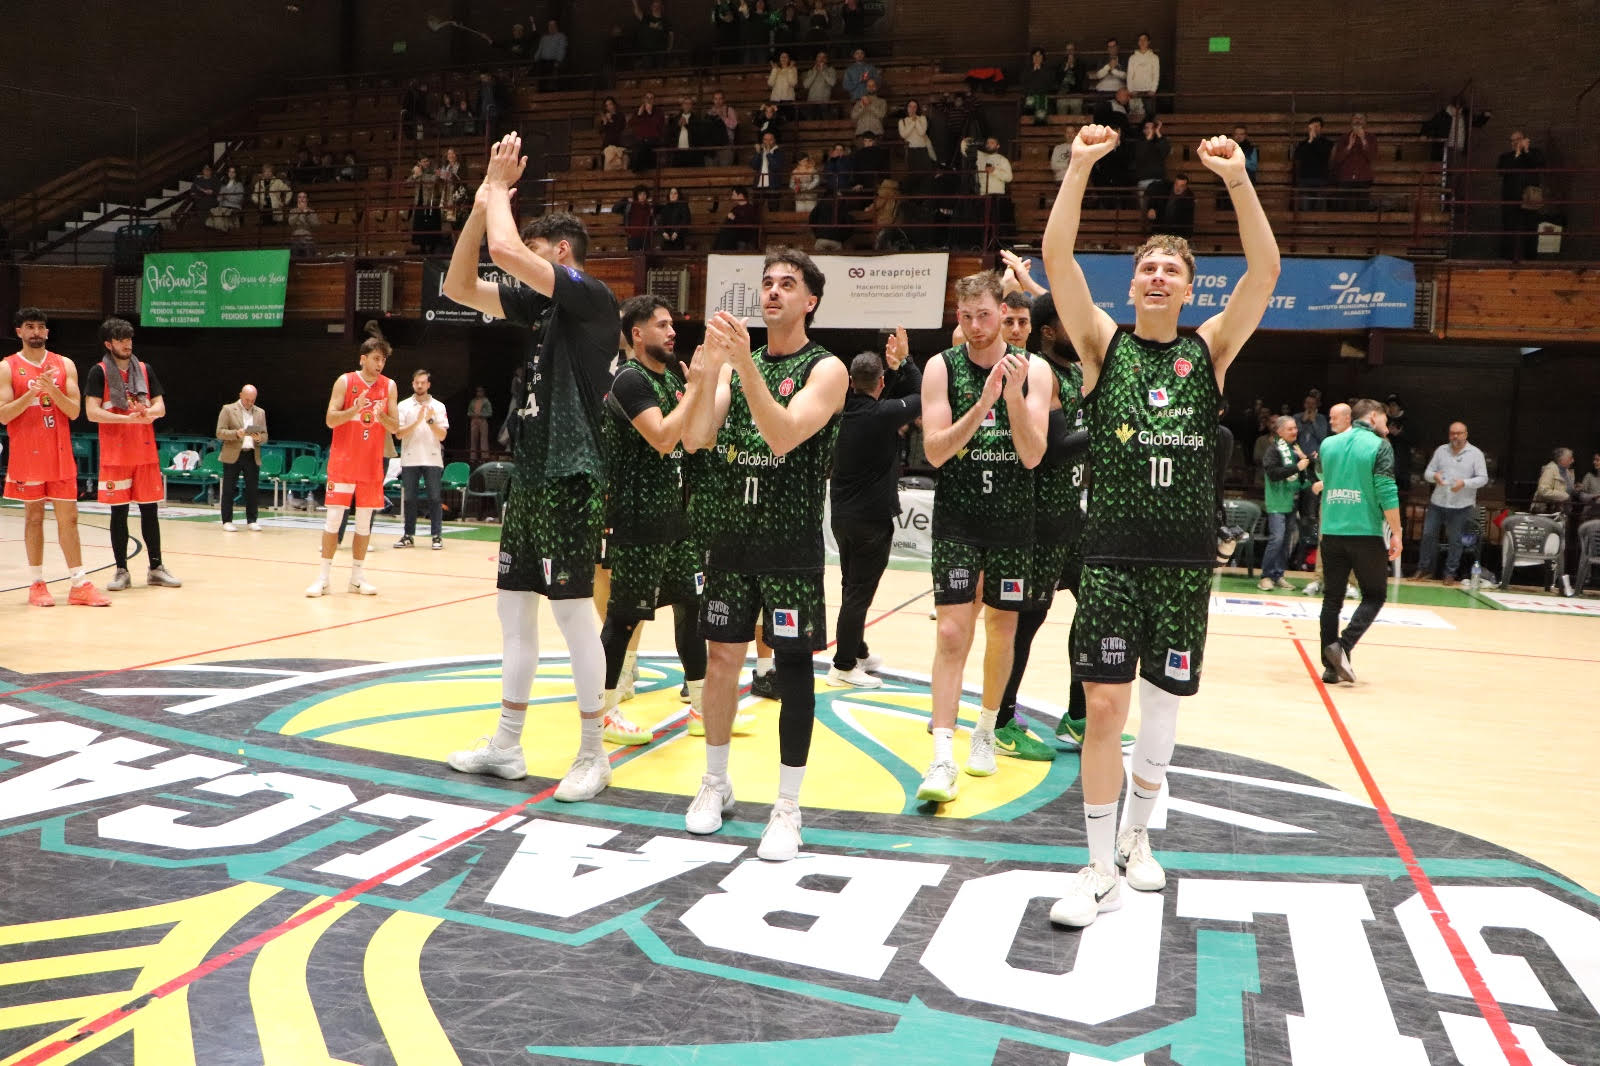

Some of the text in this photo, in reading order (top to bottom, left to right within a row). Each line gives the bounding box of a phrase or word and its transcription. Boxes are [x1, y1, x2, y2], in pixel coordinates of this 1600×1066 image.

[869, 267, 931, 278] areaproject
[905, 290, 927, 299] digital
[1197, 293, 1218, 307] EL
[221, 312, 248, 320] PEDIDOS
[1156, 406, 1194, 418] ARENAS
[43, 415, 56, 428] 15
[362, 429, 369, 441] 5
[1138, 430, 1204, 451] Globalcaja
[970, 448, 1020, 464] Globalcaj
[1148, 456, 1173, 488] 10
[982, 470, 993, 494] 5
[744, 476, 759, 505] 11
[1003, 581, 1021, 593] BA
[775, 611, 796, 627] BA
[1168, 652, 1189, 670] BA
[0, 703, 1600, 1066] GLOBALCA
